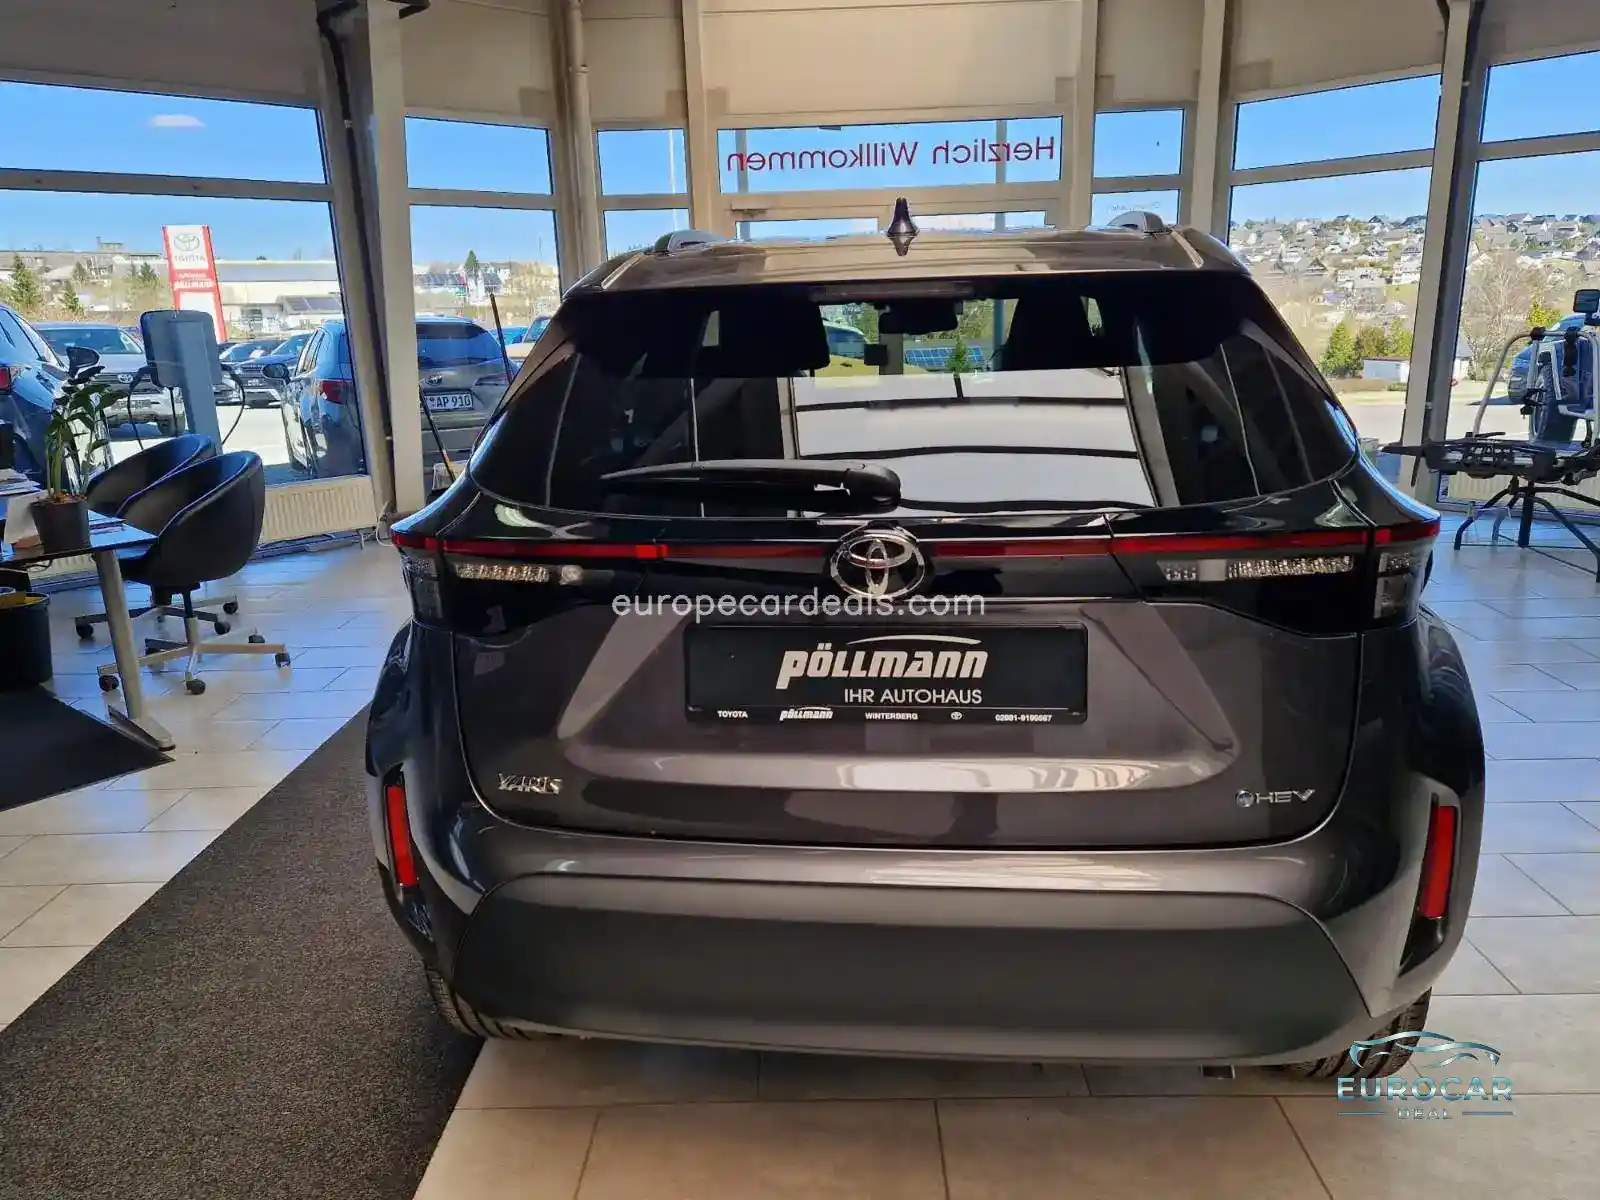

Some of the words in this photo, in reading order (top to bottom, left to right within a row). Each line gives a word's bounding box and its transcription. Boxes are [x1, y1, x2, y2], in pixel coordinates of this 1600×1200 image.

[844, 688, 875, 704] IHR
[880, 688, 983, 705] AUTOHAUS
[717, 710, 749, 719] TOYOTA
[865, 711, 919, 721] WINTERBERG
[498, 773, 563, 796] YARIS
[1255, 788, 1316, 804] HEV
